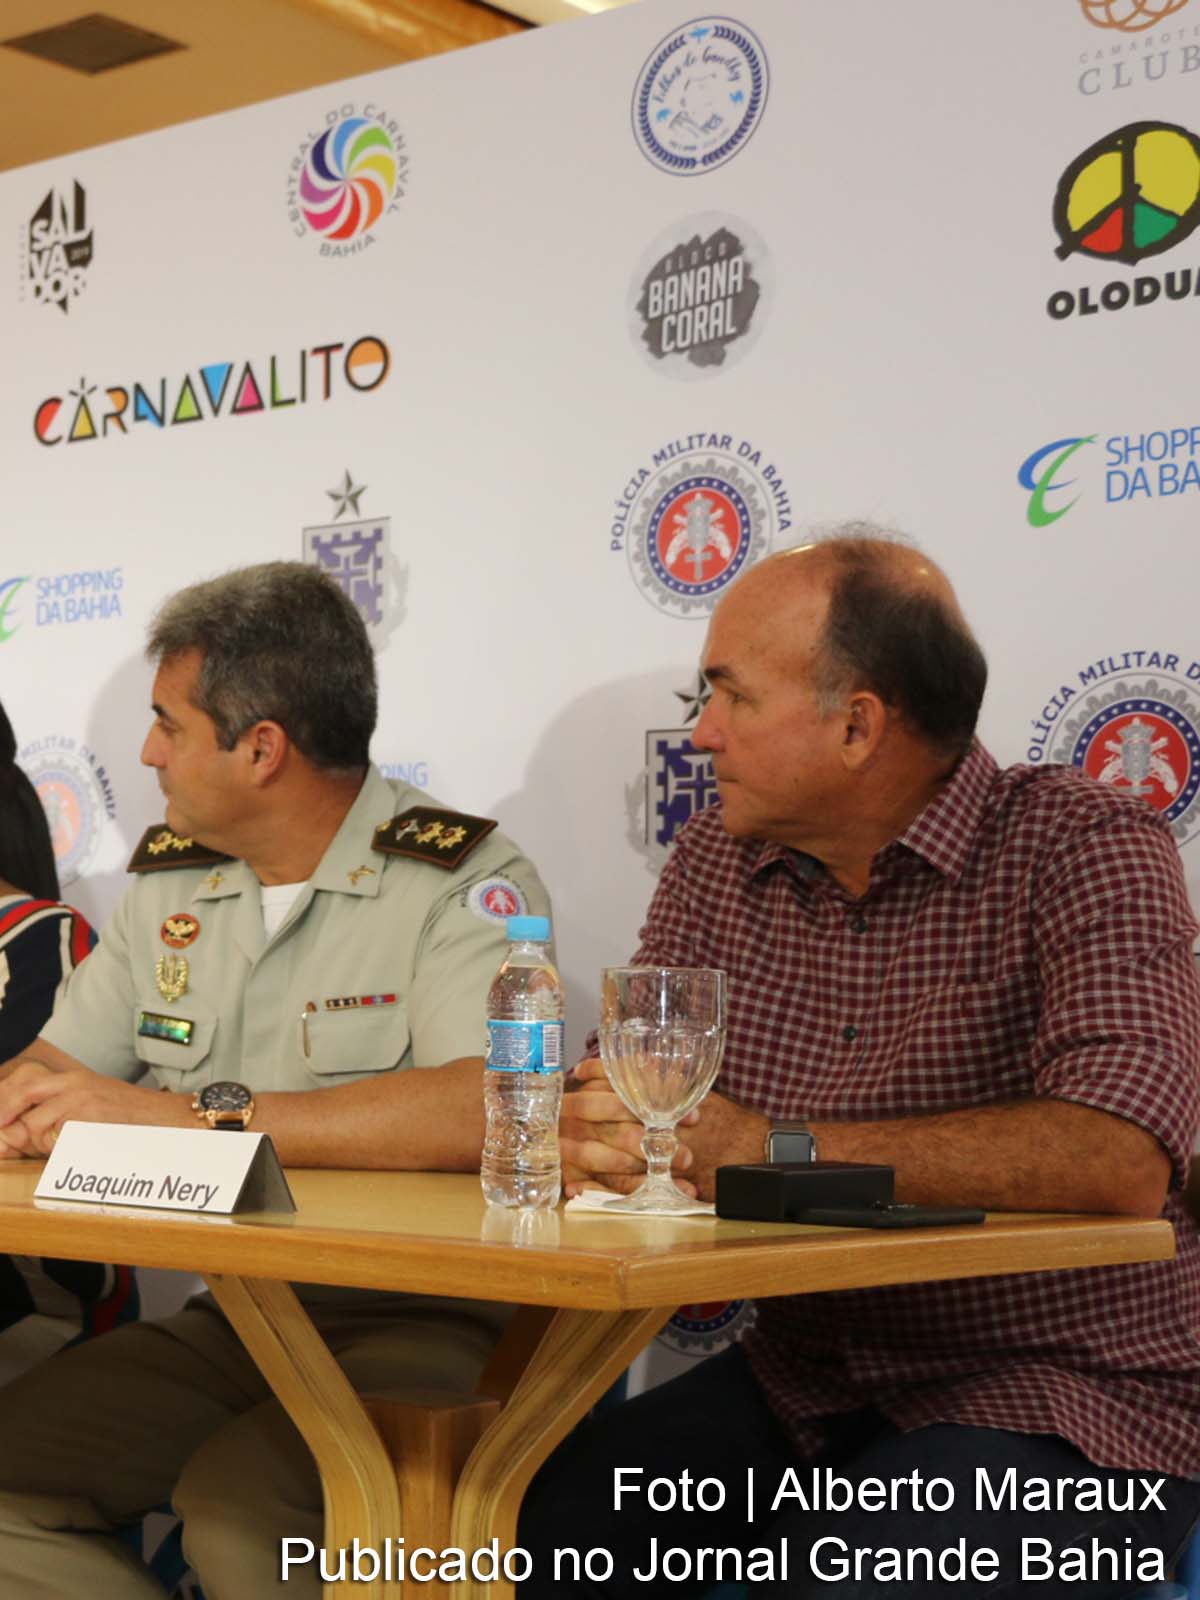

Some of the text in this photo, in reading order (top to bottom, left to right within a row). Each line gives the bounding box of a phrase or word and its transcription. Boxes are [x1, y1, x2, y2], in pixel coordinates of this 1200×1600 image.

[287, 103, 409, 239] CENTRAL DO CARNAVAL
[318, 234, 377, 258] BAHIA
[648, 255, 744, 319] BANANA
[661, 297, 737, 353] CORAL
[33, 335, 391, 447] CARNAVALITO
[610, 432, 792, 551] POLÍCIA MILITAR DA BAHIA
[1105, 466, 1152, 503] DA
[36, 567, 124, 600] SHOPPING
[36, 592, 122, 626] DA BAHIA
[1027, 685, 1077, 764] OLÍCIA
[1078, 650, 1180, 687] MILITAR
[54, 1166, 220, 1210] Joaquim Nery
